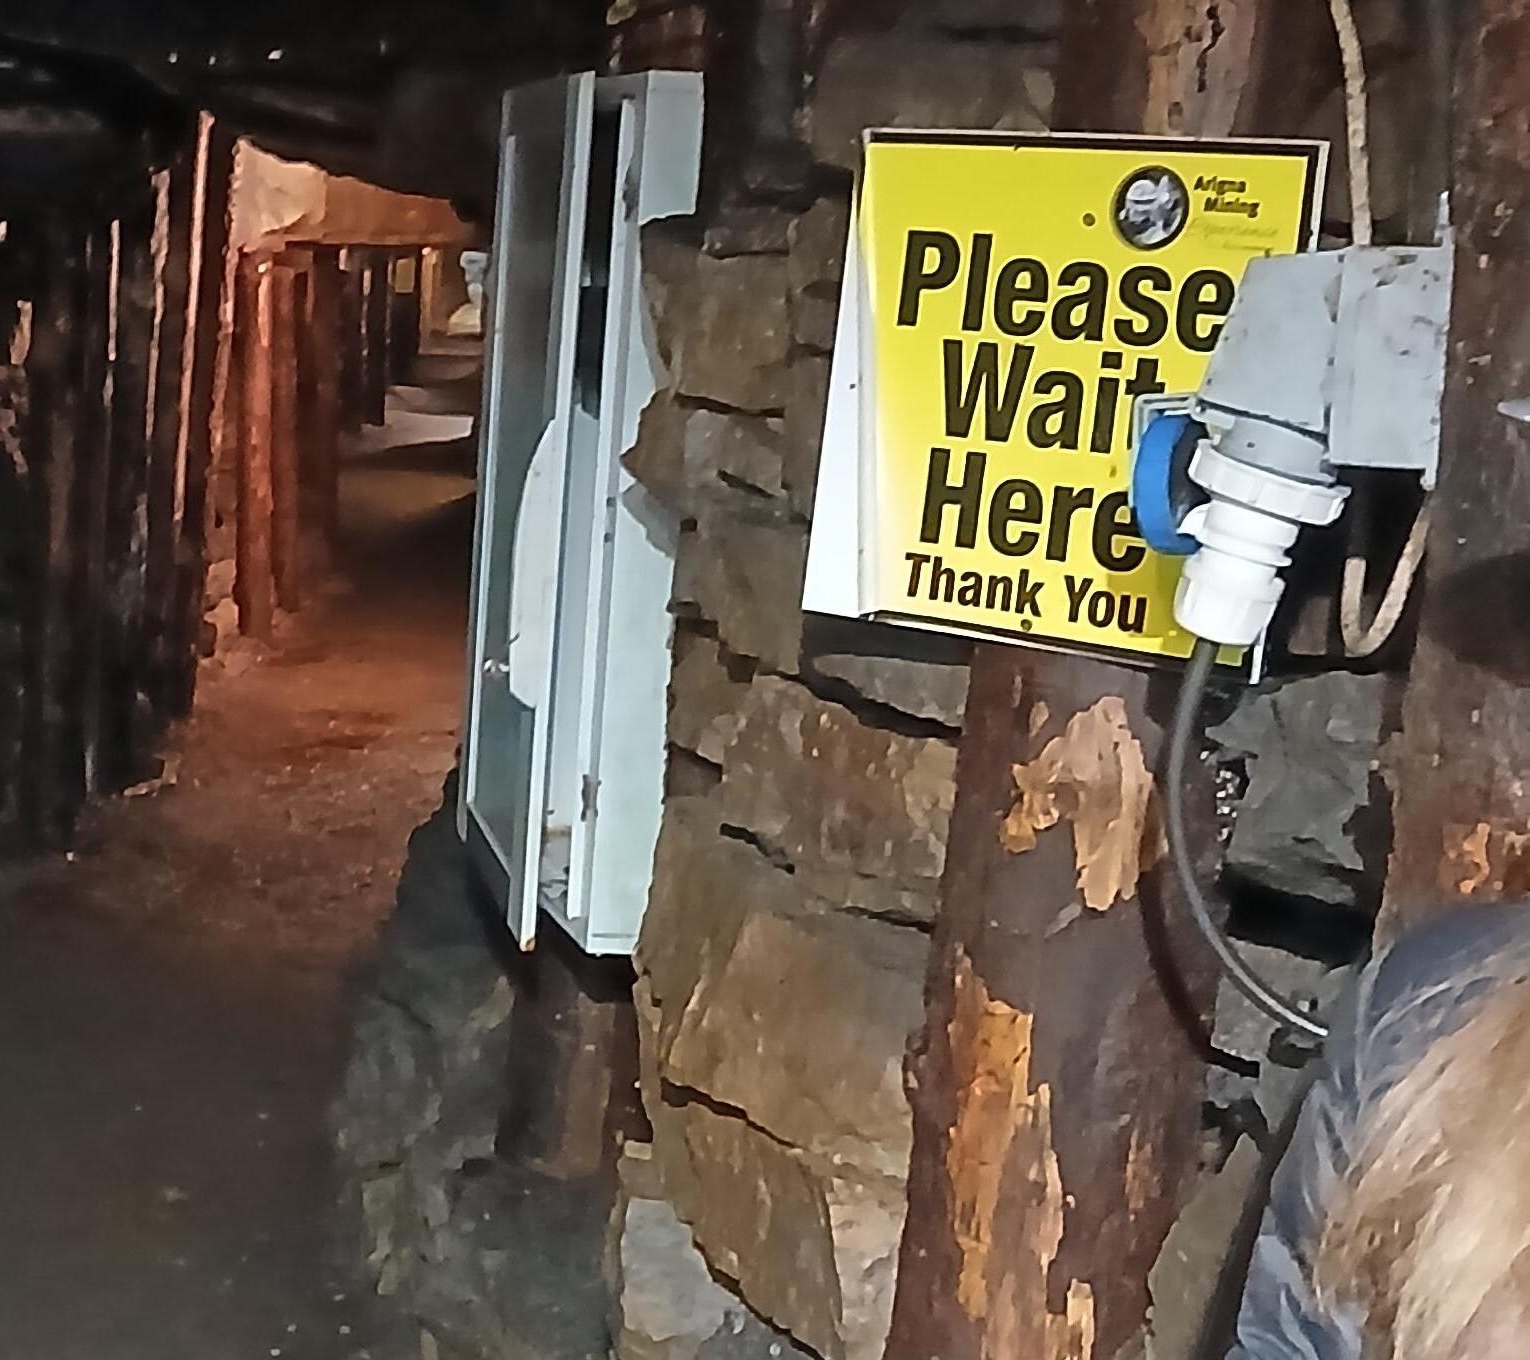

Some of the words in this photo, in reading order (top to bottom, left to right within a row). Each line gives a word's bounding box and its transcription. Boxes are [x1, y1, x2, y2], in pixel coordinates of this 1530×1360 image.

[897, 230, 1235, 352] Please
[920, 447, 1146, 572] Here
[905, 552, 1045, 618] Thank
[1064, 575, 1147, 634] You
